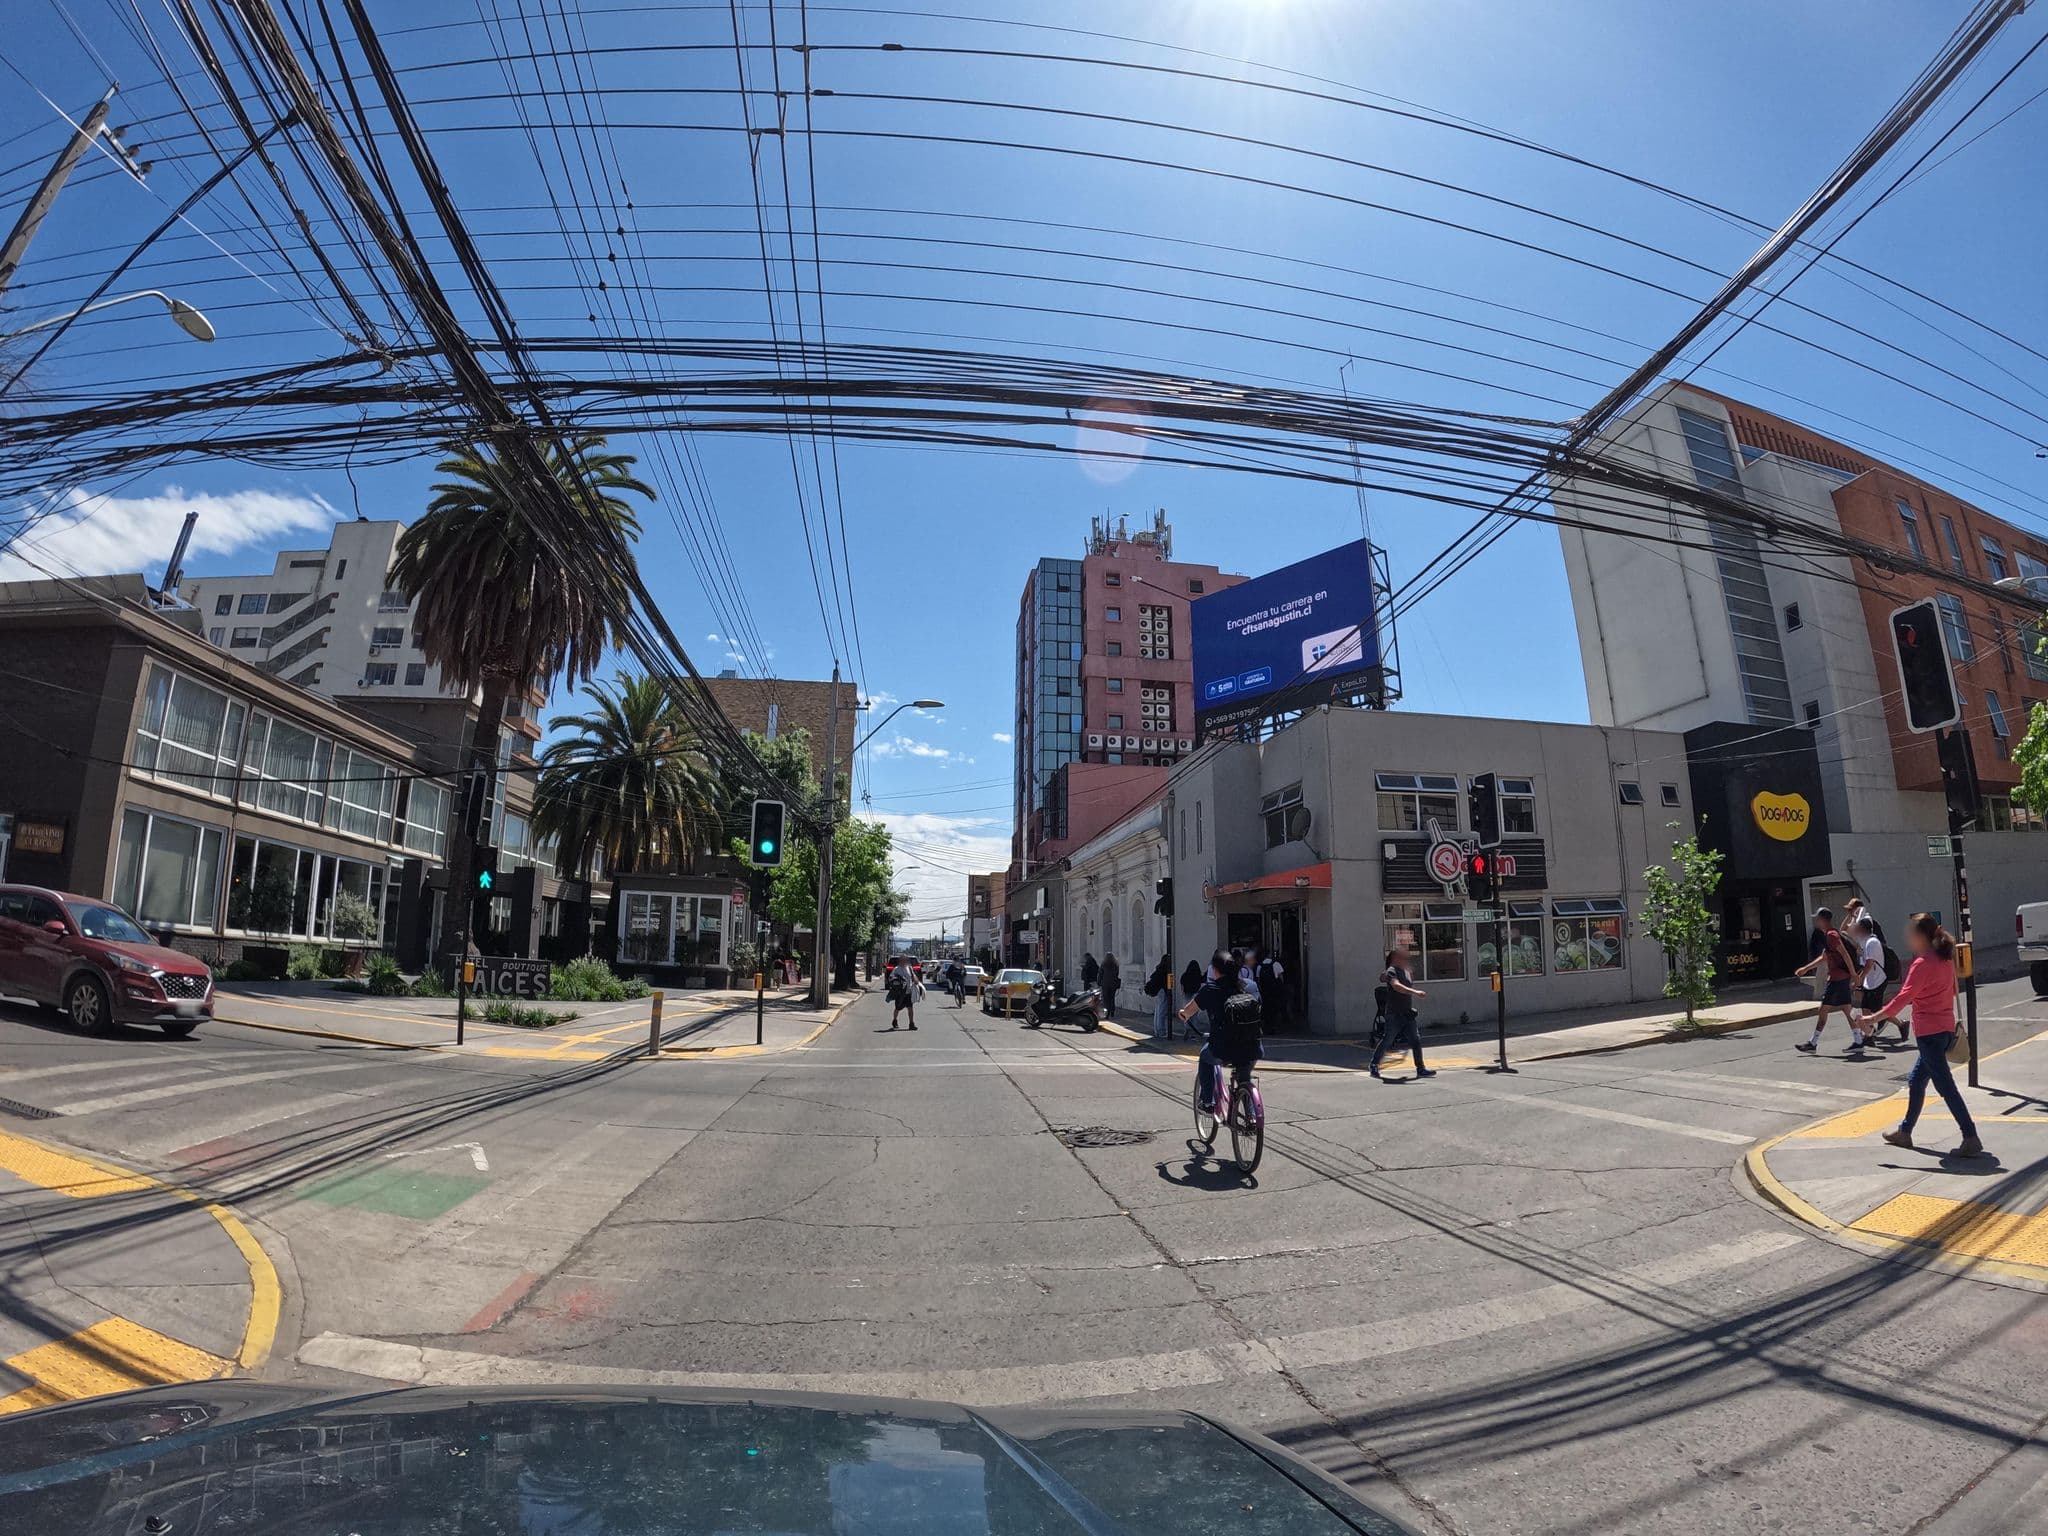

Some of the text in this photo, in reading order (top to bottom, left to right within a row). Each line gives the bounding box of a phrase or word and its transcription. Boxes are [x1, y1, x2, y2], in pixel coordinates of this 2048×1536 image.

[1227, 590, 1327, 630] Encuentra tu carrera en
[1241, 604, 1312, 635] cftsanagustin.cl
[455, 956, 548, 972] HTEL BOUTIQUE
